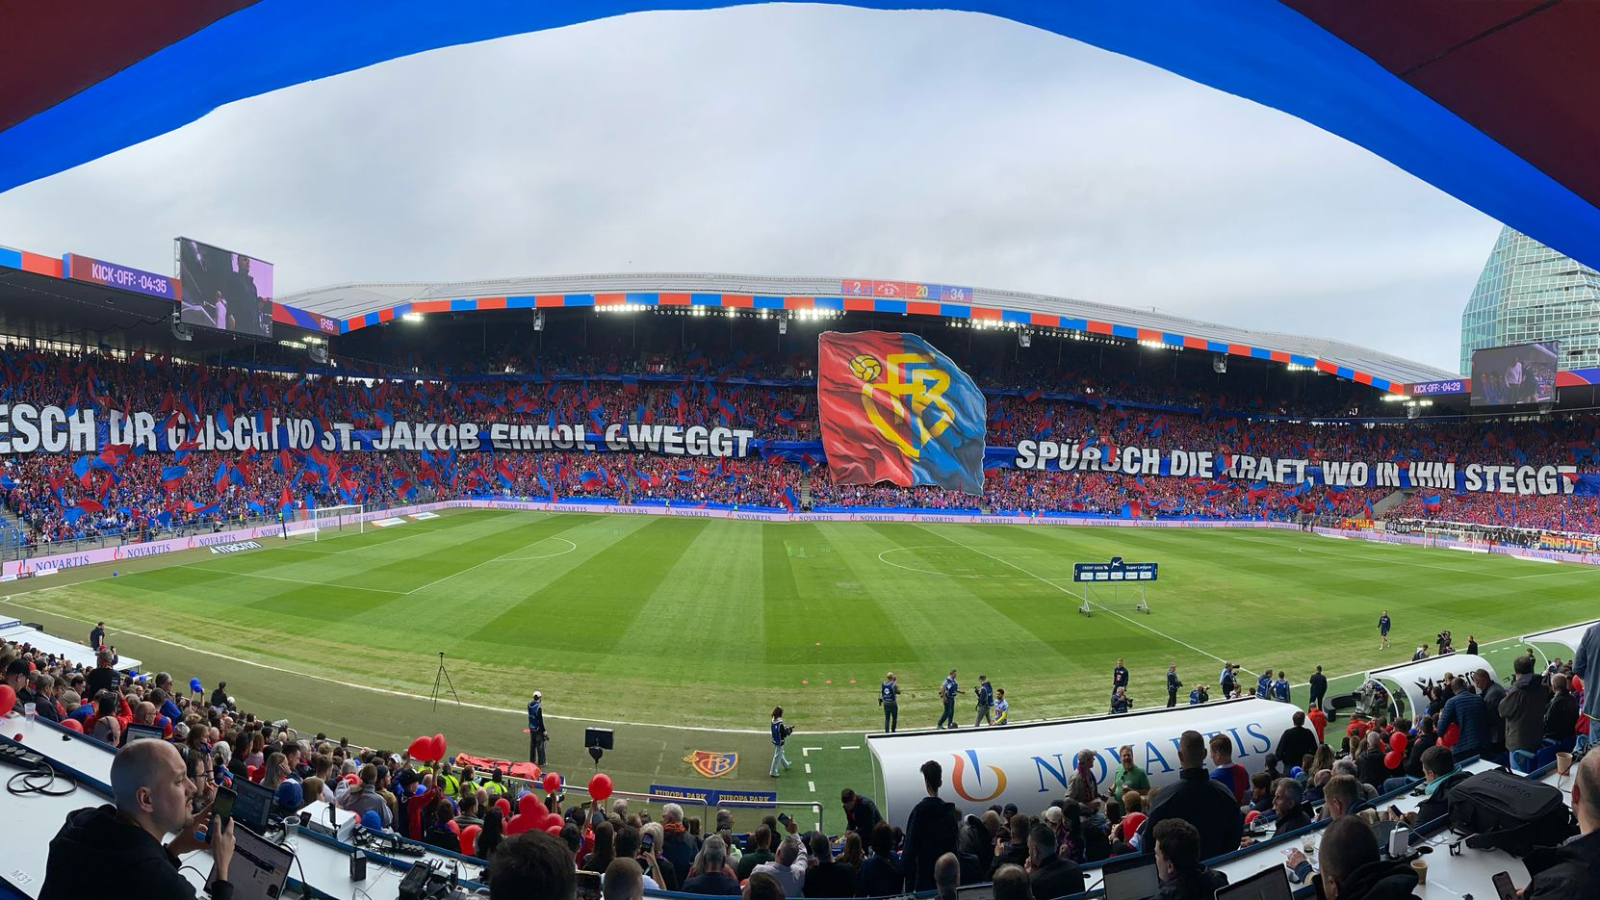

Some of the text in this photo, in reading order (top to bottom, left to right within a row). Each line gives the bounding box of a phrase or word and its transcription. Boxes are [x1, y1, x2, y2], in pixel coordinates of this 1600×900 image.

[92, 263, 167, 294] KICK-OFF: -04:35
[853, 282, 861, 294] 2
[916, 285, 928, 298] 20
[951, 288, 964, 300] 34
[1413, 383, 1440, 394] KICK-OFF:
[110, 409, 157, 451] DR
[168, 411, 280, 451] GISCHT
[287, 417, 315, 450] VO
[373, 420, 478, 450] JAKOB
[605, 423, 753, 458] GWEGGT
[1170, 449, 1213, 478] DIE
[1322, 460, 1368, 487] WO
[1376, 460, 1400, 487] IN
[1408, 461, 1455, 489] IHM
[1465, 463, 1577, 495] STEGGT
[675, 509, 710, 517] NOVARTIS
[799, 514, 833, 522] NOVARTIS
[860, 514, 894, 522] NOVARTIS
[921, 515, 955, 523] NOVARTIS
[980, 517, 1013, 525] NOVARTIS
[199, 533, 236, 547] NOVARTIS
[127, 543, 171, 558] NOVARTIS
[1531, 551, 1565, 560] NOVARTIS
[36, 555, 90, 571] NOVARTIS
[1030, 722, 1271, 793] NOVAIS
